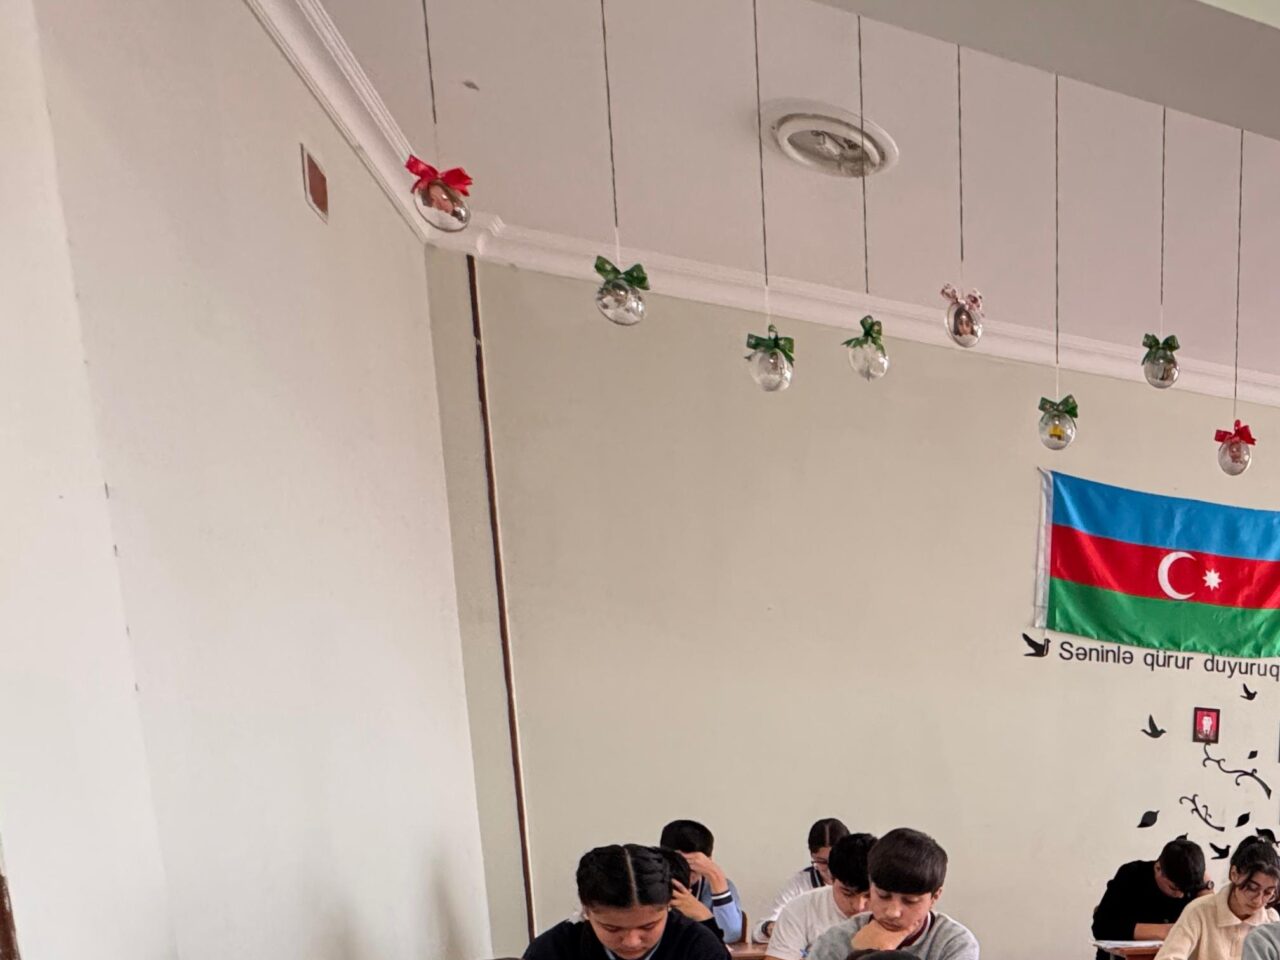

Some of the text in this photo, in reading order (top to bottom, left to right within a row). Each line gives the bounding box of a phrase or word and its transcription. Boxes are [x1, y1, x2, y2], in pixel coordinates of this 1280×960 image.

[1059, 641, 1280, 682] Səninlə qürur duyuruq
